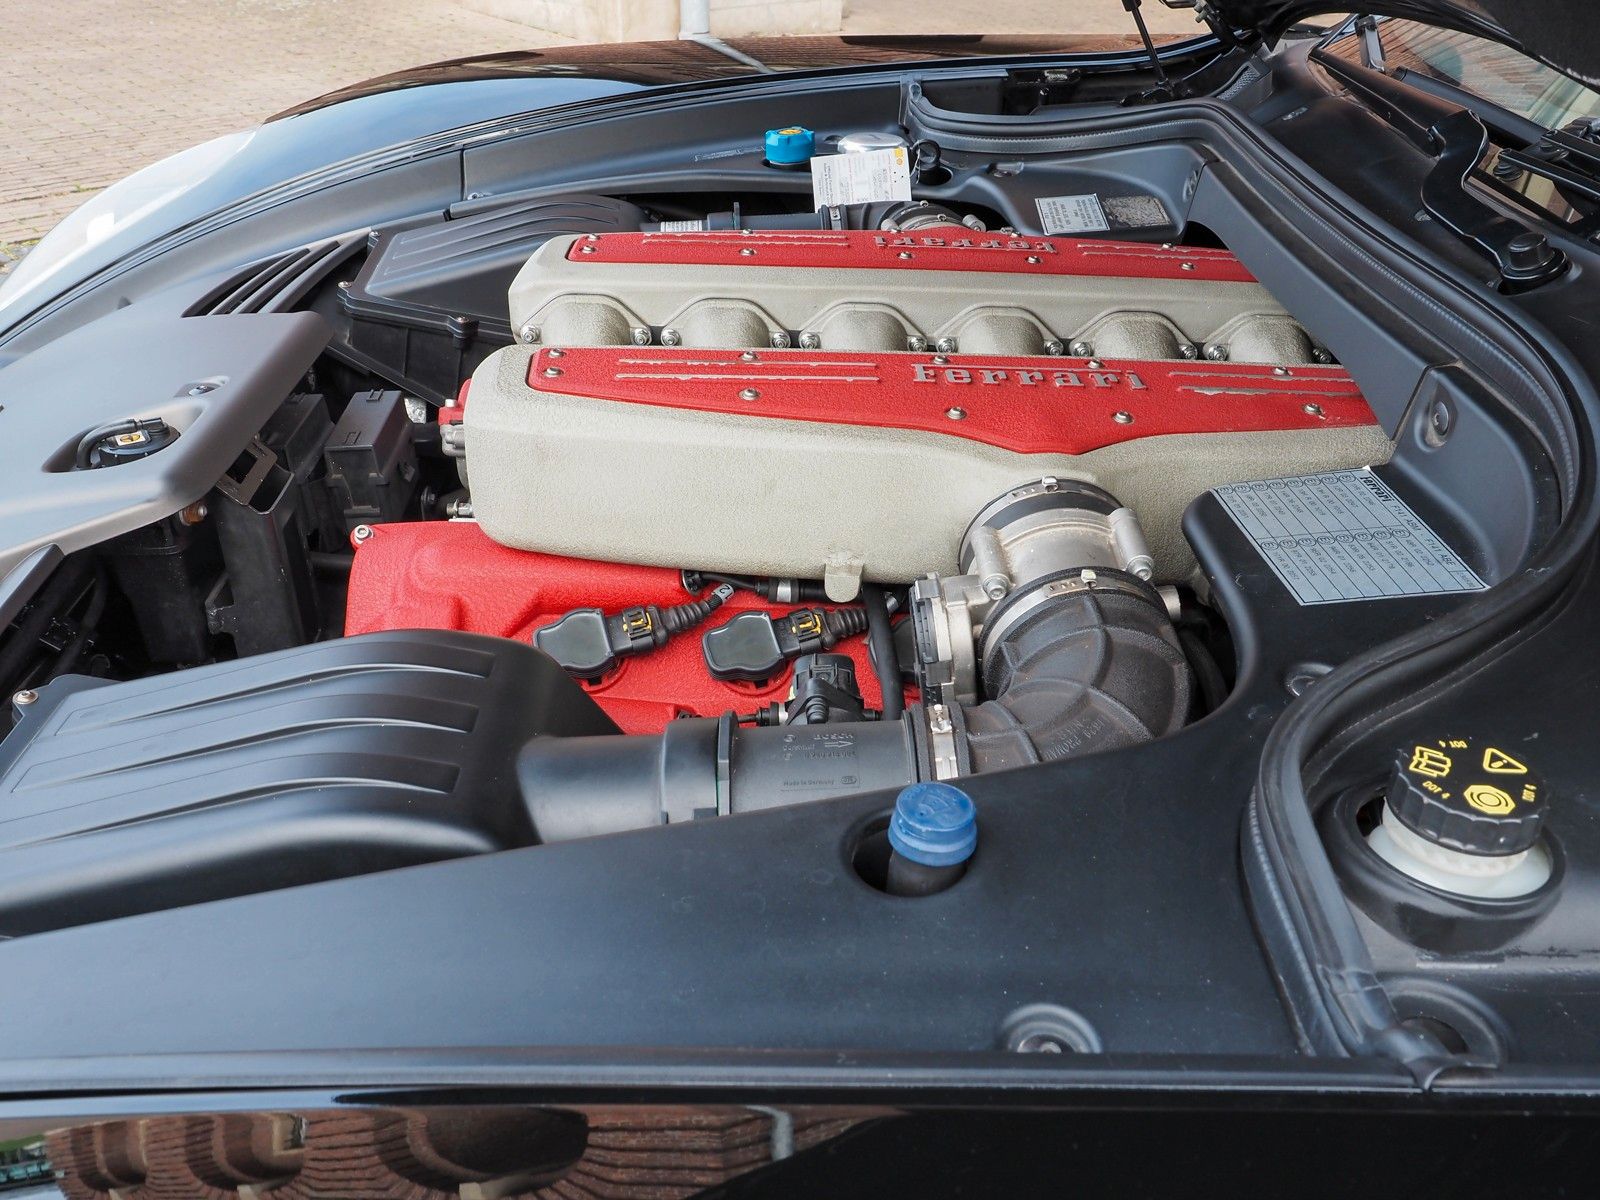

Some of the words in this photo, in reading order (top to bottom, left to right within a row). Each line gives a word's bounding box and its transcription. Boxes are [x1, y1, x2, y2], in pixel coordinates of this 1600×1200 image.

[911, 363, 1149, 391] Ferrari
[1358, 476, 1395, 502] Ferrari
[1422, 780, 1442, 793] DOT
